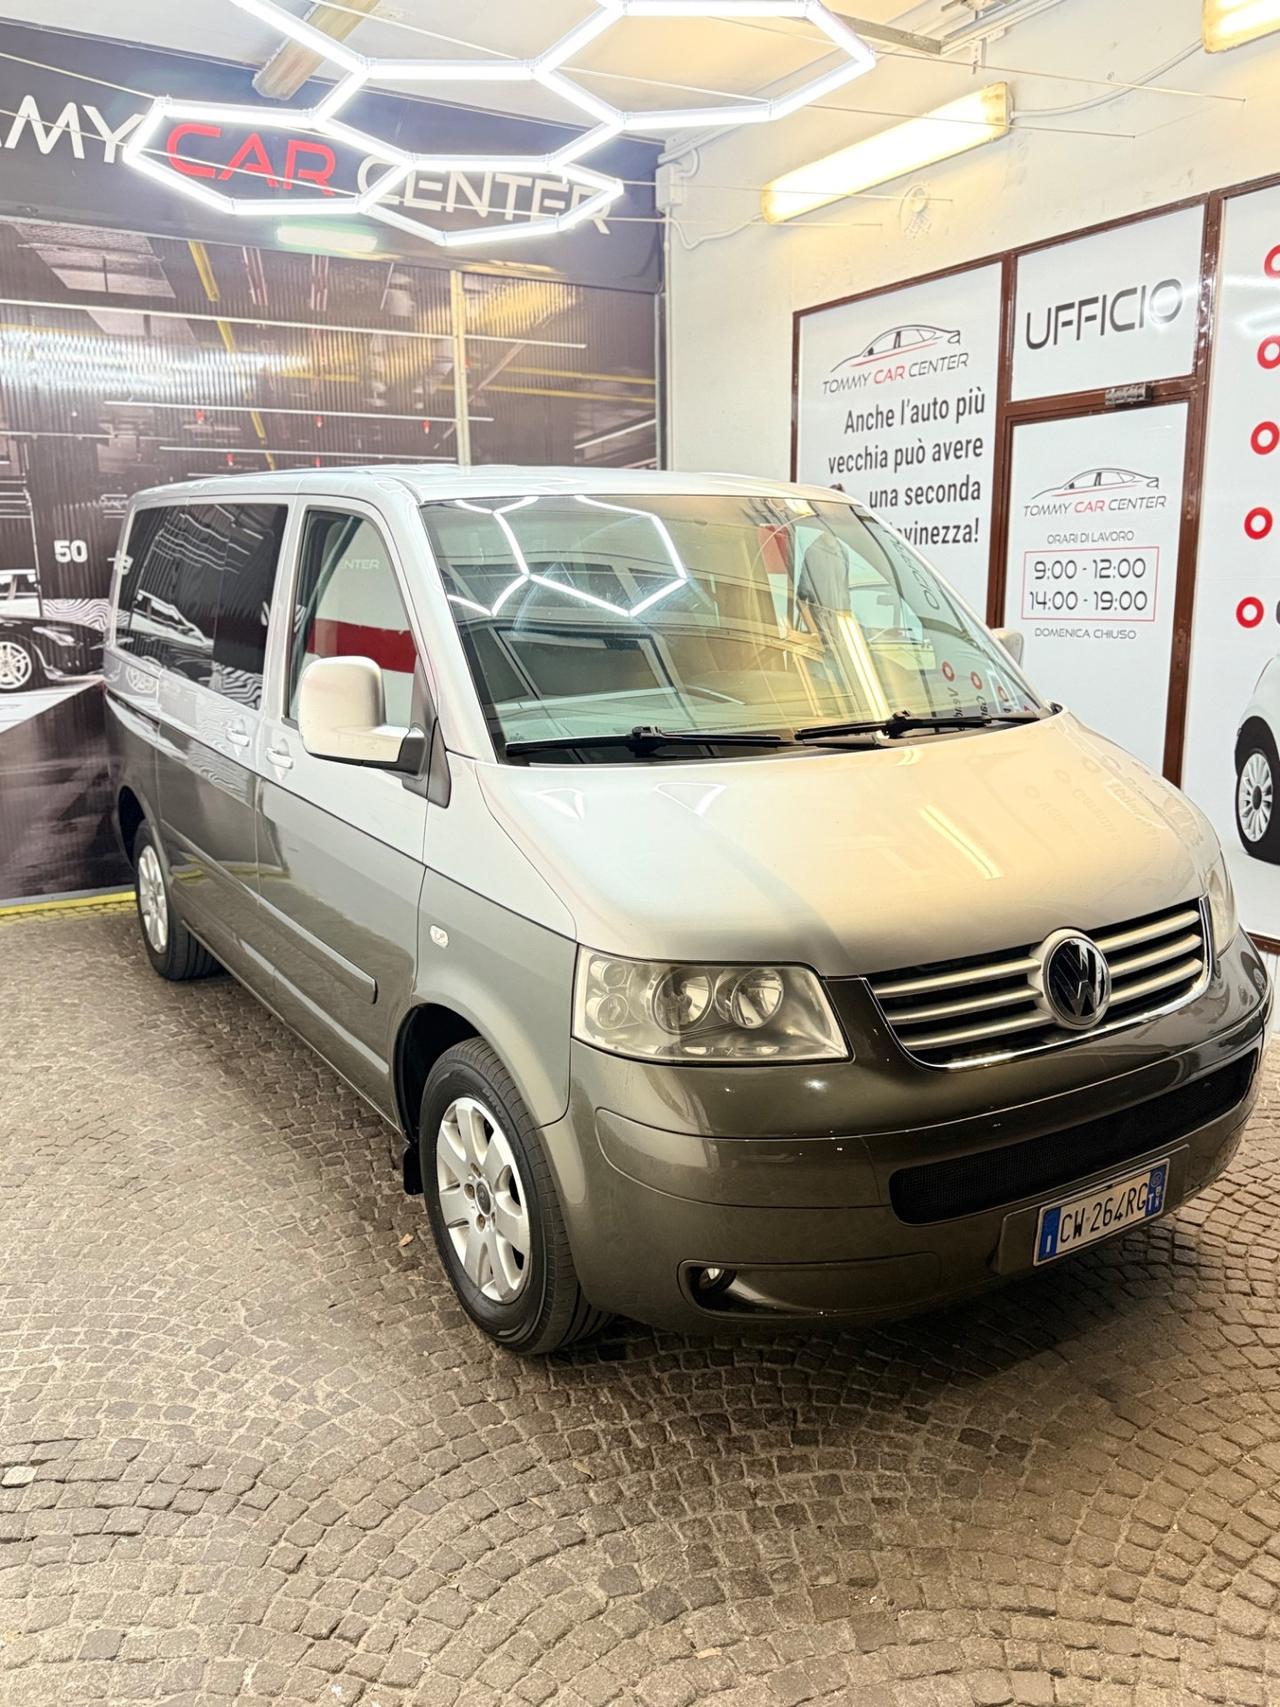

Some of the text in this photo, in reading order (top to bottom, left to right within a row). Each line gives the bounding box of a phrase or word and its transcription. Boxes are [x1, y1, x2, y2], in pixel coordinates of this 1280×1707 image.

[0, 95, 611, 234] MY CAR CENTER
[1026, 278, 1183, 350] UFFICIO
[822, 352, 969, 394] TOMMY CAR CENTER
[844, 386, 986, 434] Anche l'auto più
[828, 437, 984, 474] vecchia può avere
[869, 474, 981, 508] una seconda
[1023, 495, 1167, 517] TOMMY CAR CENTER
[892, 517, 979, 546] vinezza!
[1047, 530, 1135, 545] ORARI DI LAVORO
[54, 539, 88, 564] 50
[1034, 559, 1077, 580] 9:00
[1093, 558, 1146, 579] 12:00
[1029, 591, 1078, 611] 14:00
[1093, 591, 1148, 611] 19:00
[1034, 628, 1137, 640] DOMENICA CHIUSO
